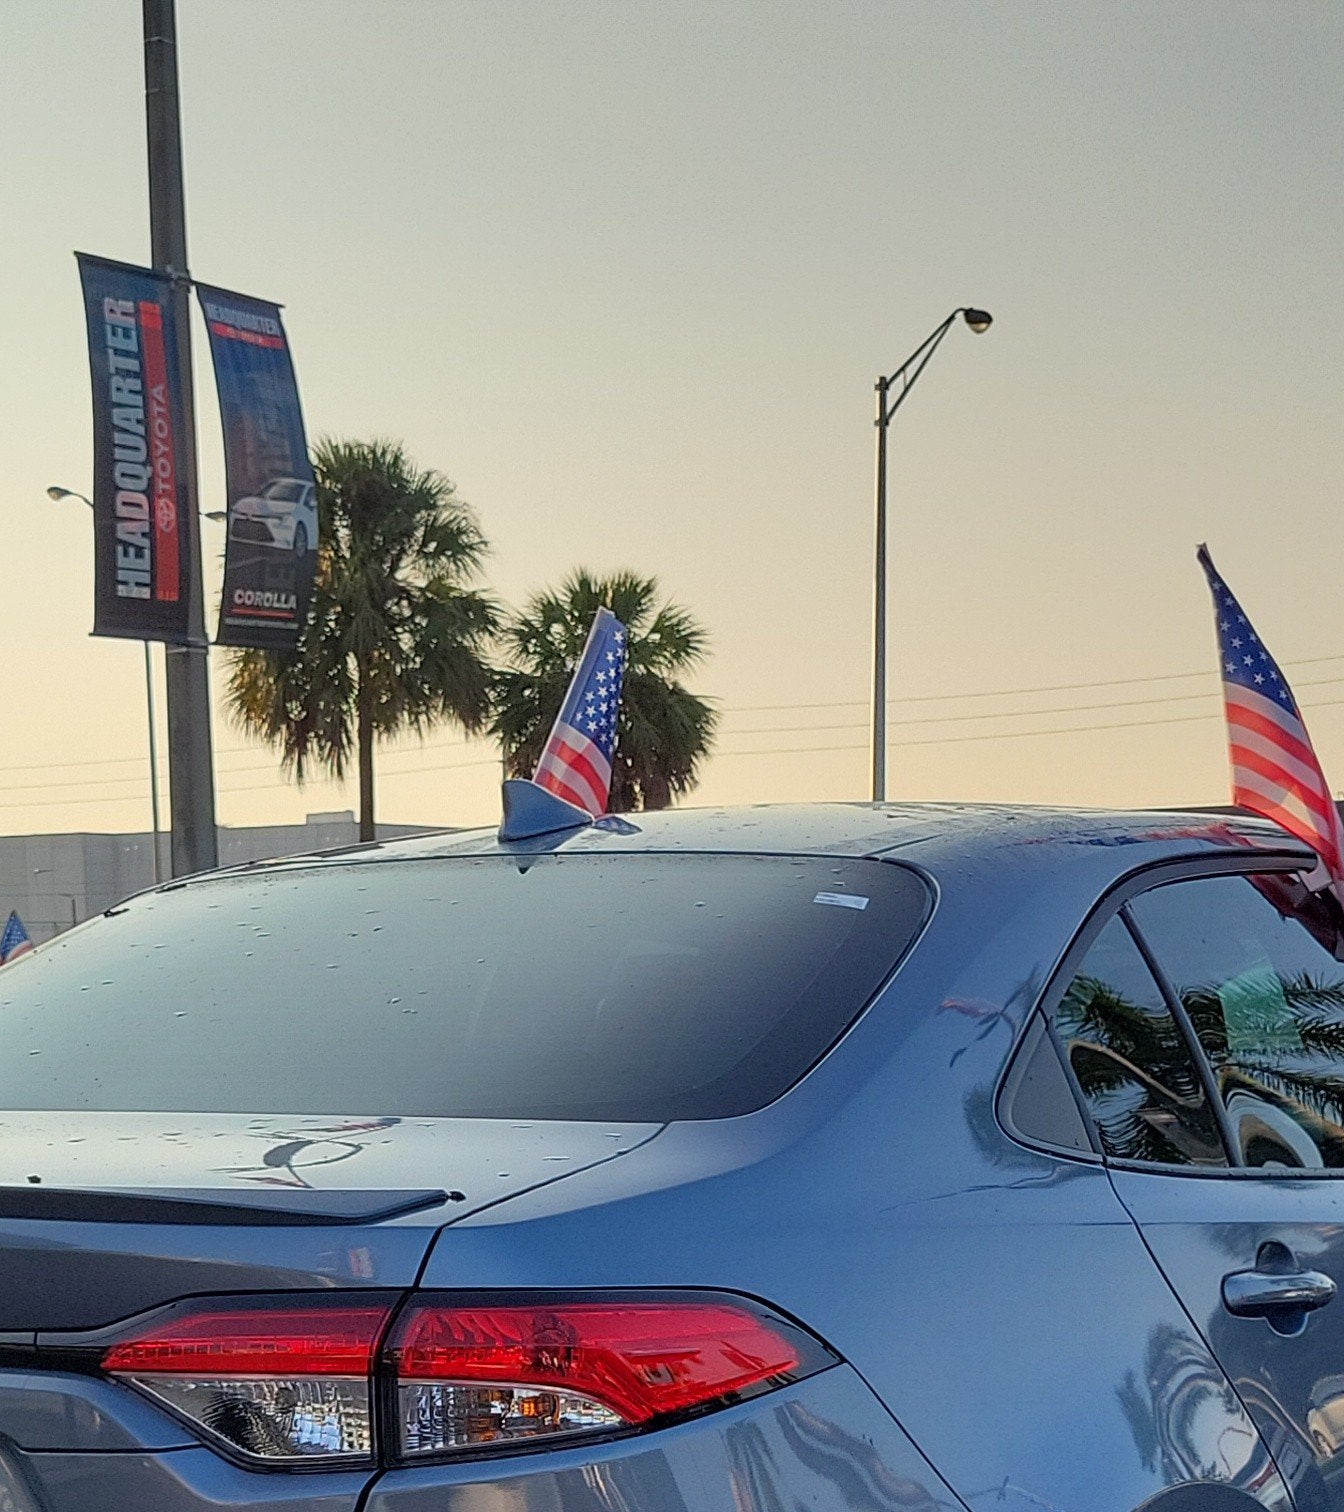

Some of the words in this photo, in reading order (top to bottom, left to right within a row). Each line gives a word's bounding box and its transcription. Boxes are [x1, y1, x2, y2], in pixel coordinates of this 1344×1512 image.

[104, 297, 153, 600] HEADQUARTER
[151, 383, 174, 494] TOYOTA
[234, 588, 297, 610] COROLLA
